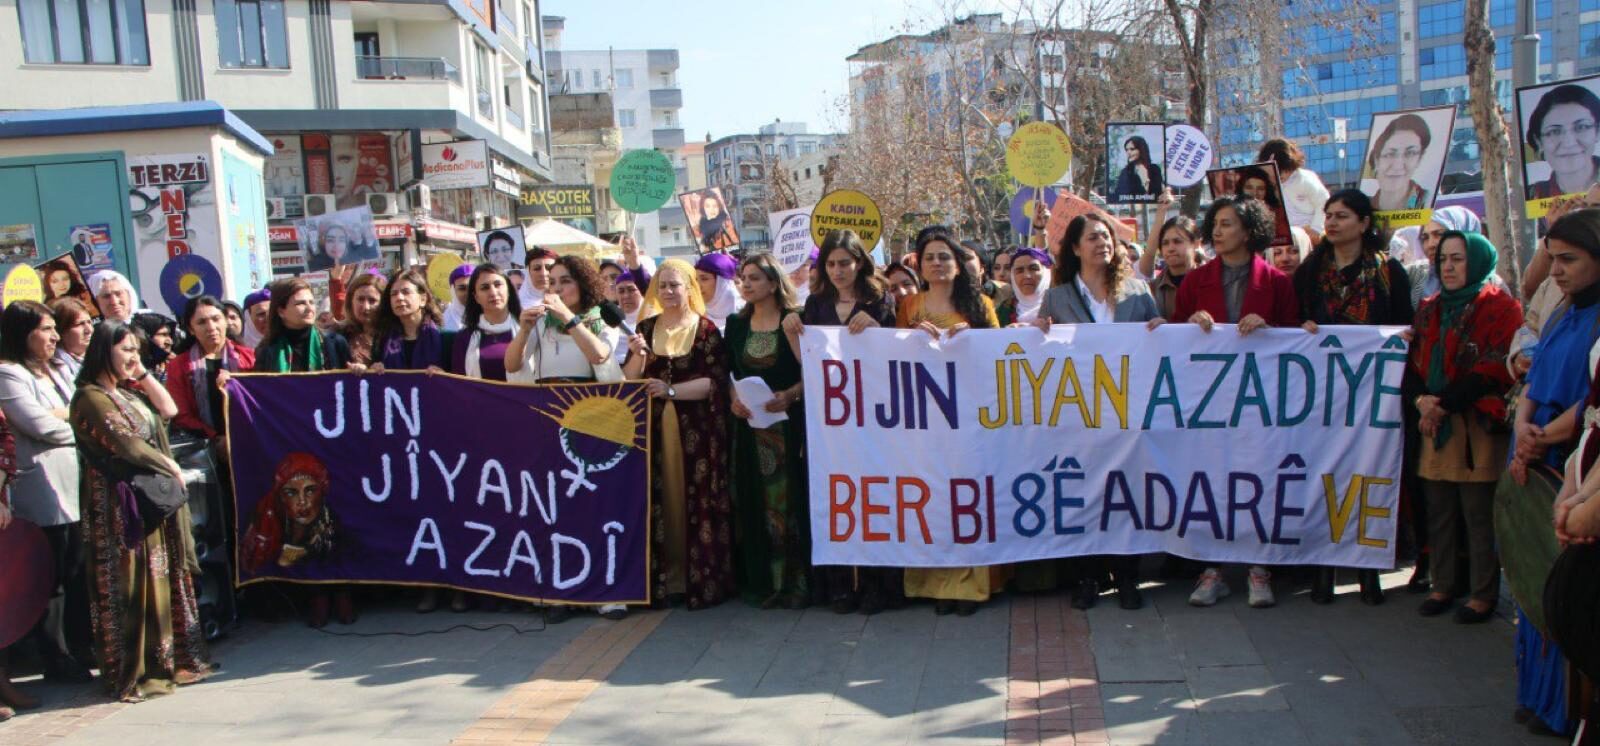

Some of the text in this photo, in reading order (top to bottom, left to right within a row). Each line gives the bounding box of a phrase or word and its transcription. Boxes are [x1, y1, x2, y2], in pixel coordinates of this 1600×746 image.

[130, 156, 207, 185] TERZİ
[815, 215, 879, 228] TUTSAKLARA
[830, 204, 866, 215] KADIN
[313, 379, 421, 439] JIN
[822, 334, 1409, 430] BI JIN JÎYAN AZADÎYÊ
[361, 439, 557, 525] JÎYAN
[829, 473, 934, 545] BER
[950, 475, 997, 544] BI
[1100, 453, 1307, 546] ADARÊ
[1321, 472, 1393, 548] VE
[405, 518, 625, 590] AZADÎ
